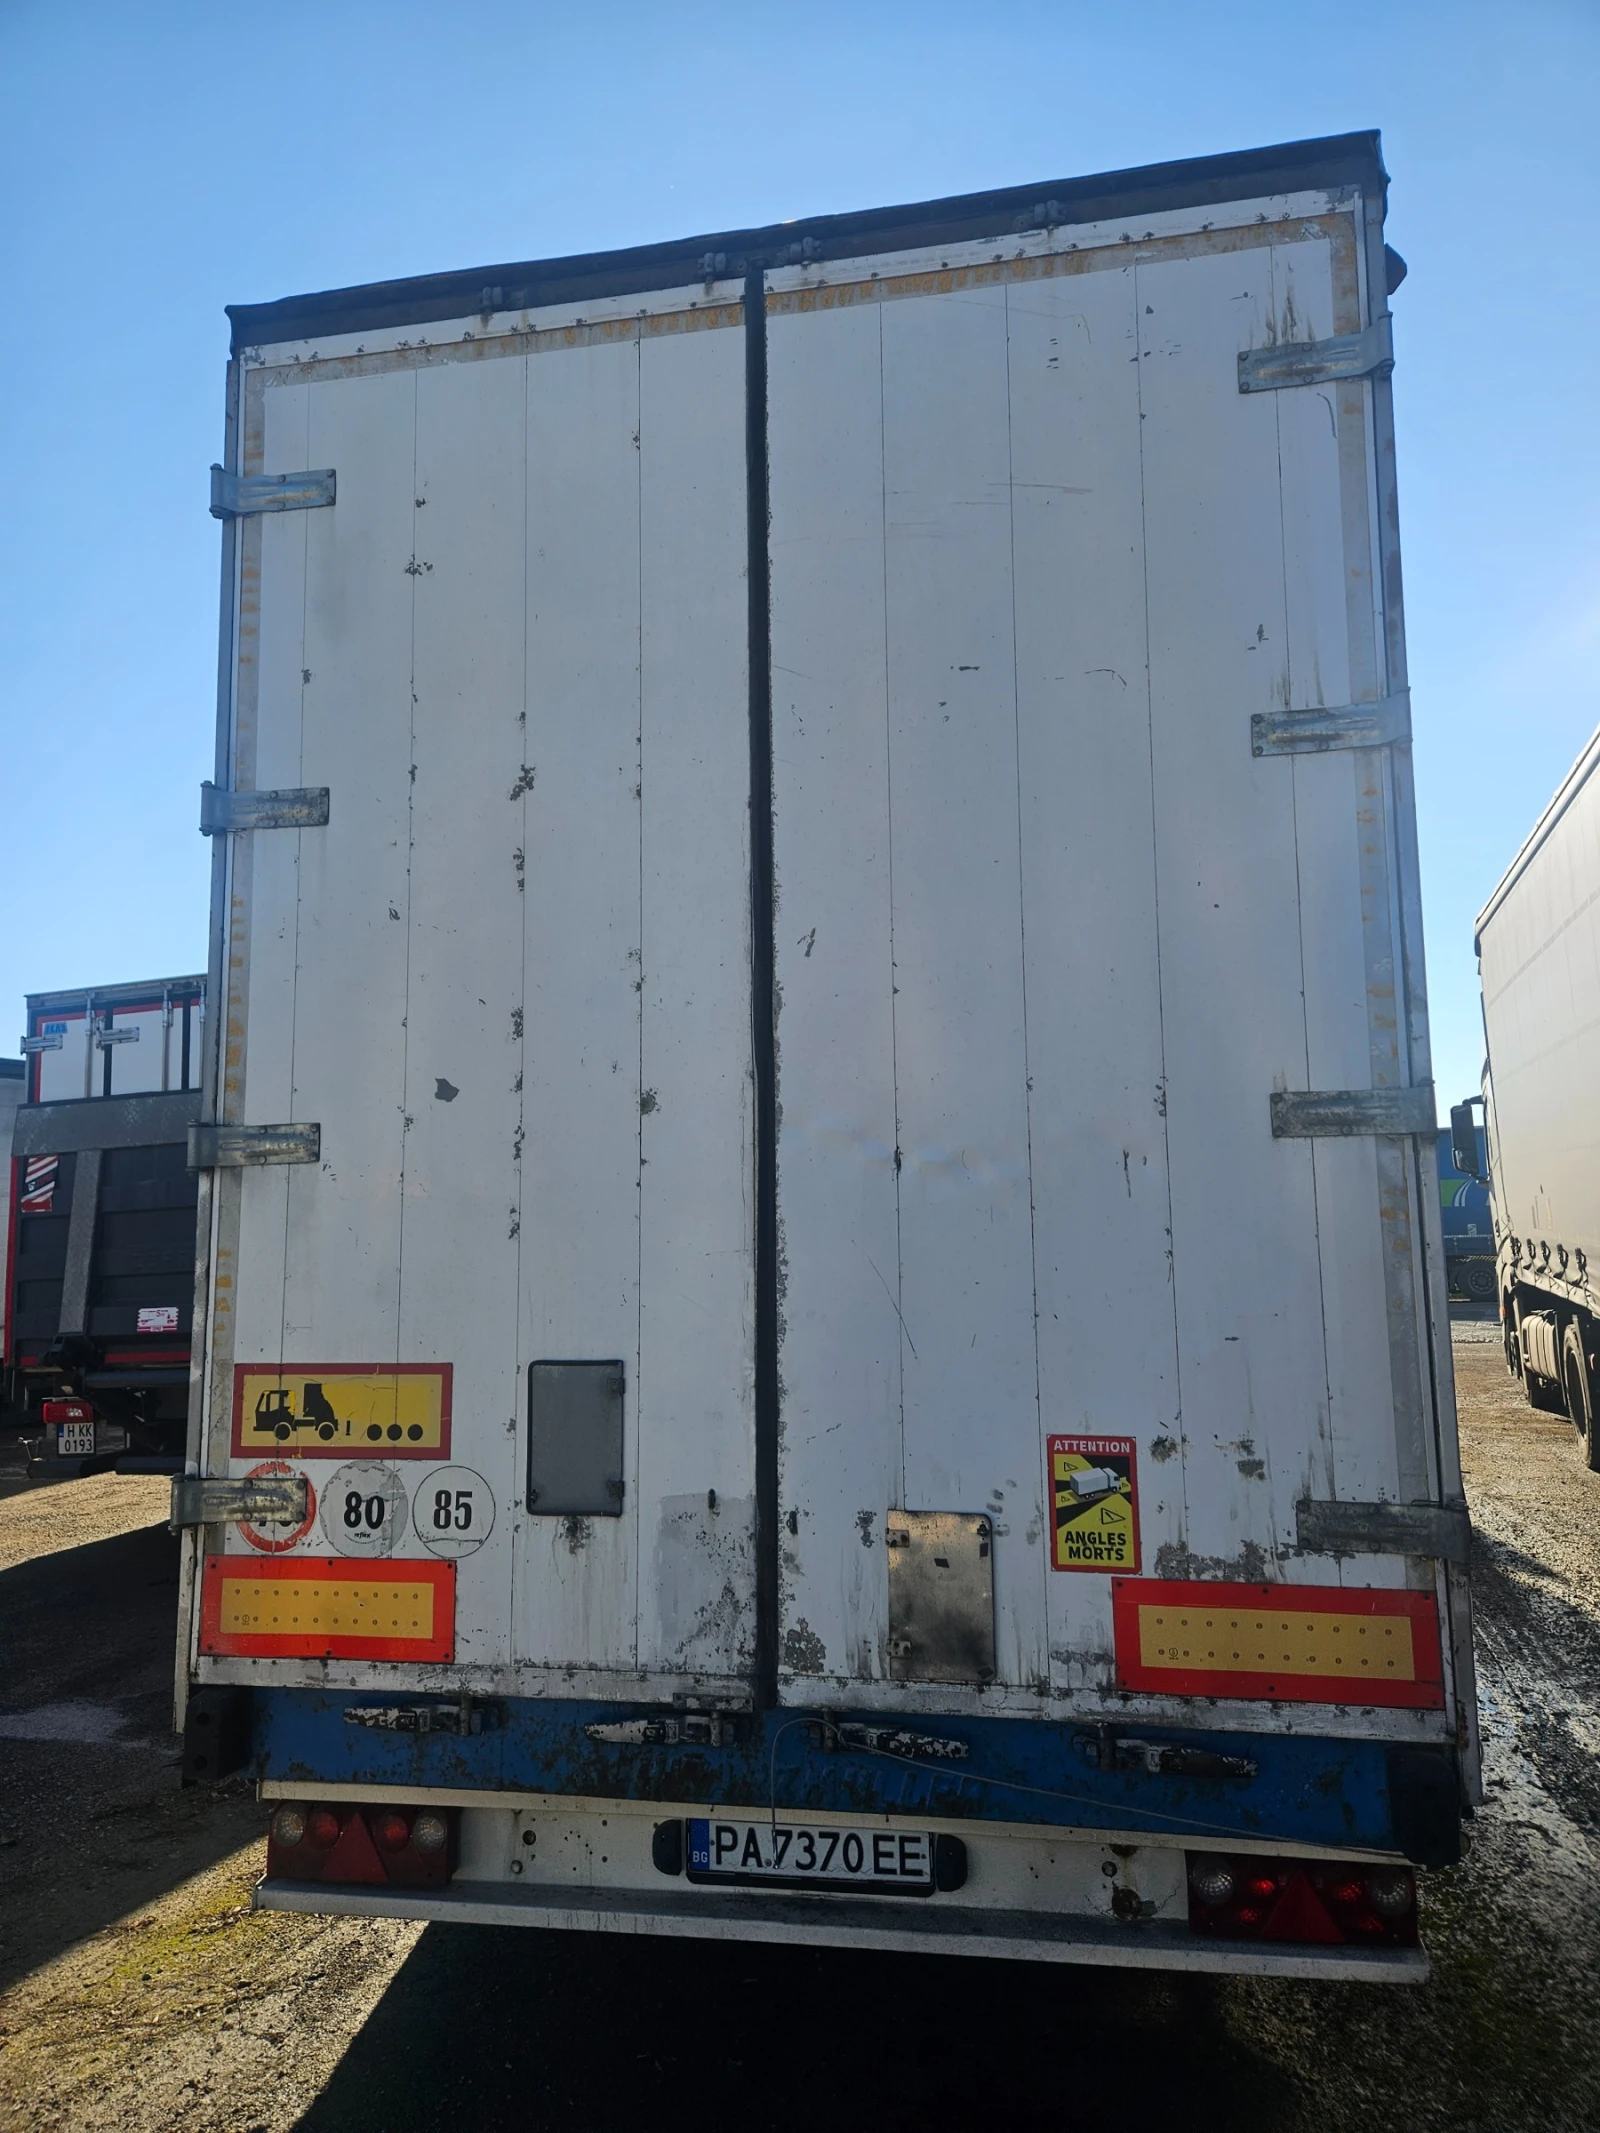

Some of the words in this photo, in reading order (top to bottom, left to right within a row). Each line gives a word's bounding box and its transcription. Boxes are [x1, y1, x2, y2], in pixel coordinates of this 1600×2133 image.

[67, 1425, 75, 1437] H
[79, 1424, 92, 1437] KK
[65, 1439, 93, 1452] 0193
[1054, 1440, 1130, 1453] ATTENTION
[344, 1491, 385, 1530] 80
[433, 1489, 473, 1530] 85
[1064, 1531, 1127, 1546] ANGLES
[1068, 1546, 1125, 1561] MORTS
[692, 1851, 708, 1863] BG
